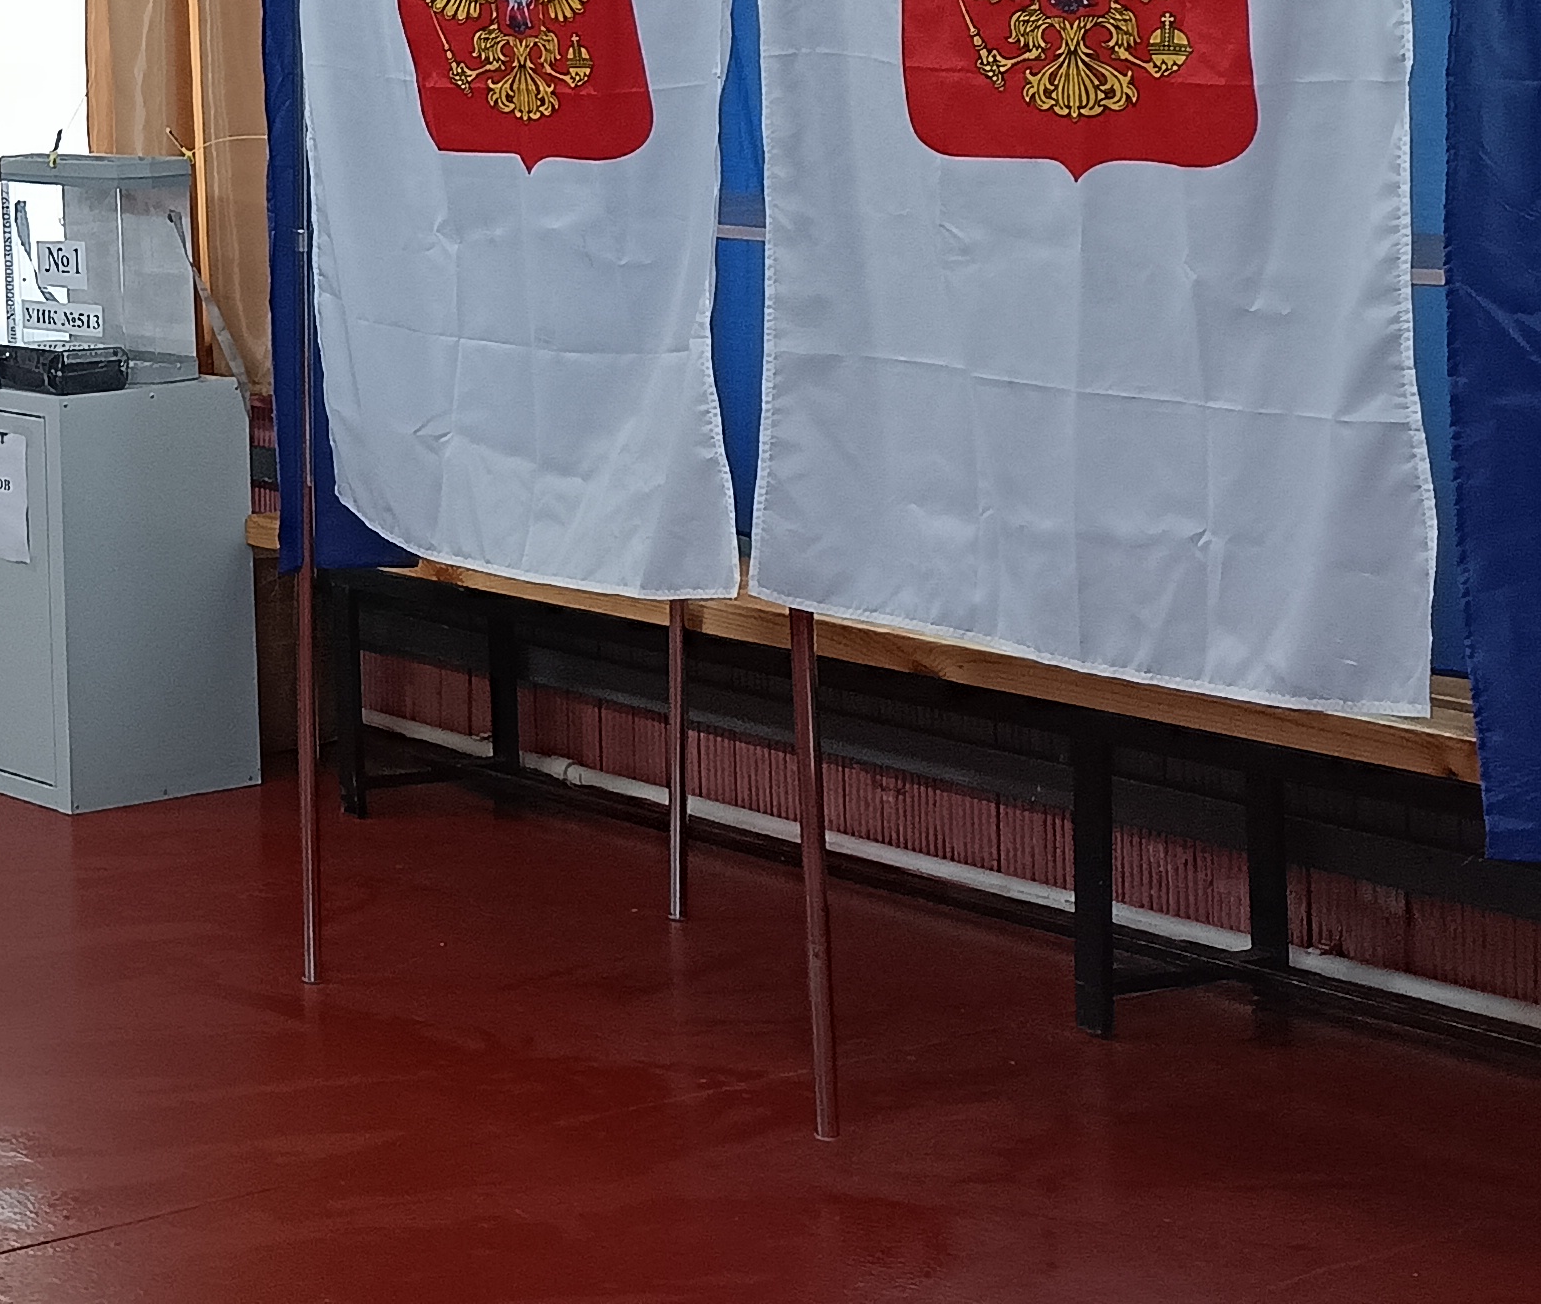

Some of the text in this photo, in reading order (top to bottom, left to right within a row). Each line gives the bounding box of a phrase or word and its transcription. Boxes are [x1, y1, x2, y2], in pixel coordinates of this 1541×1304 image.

[44, 246, 82, 275] №1
[25, 307, 101, 330] УИК №513
